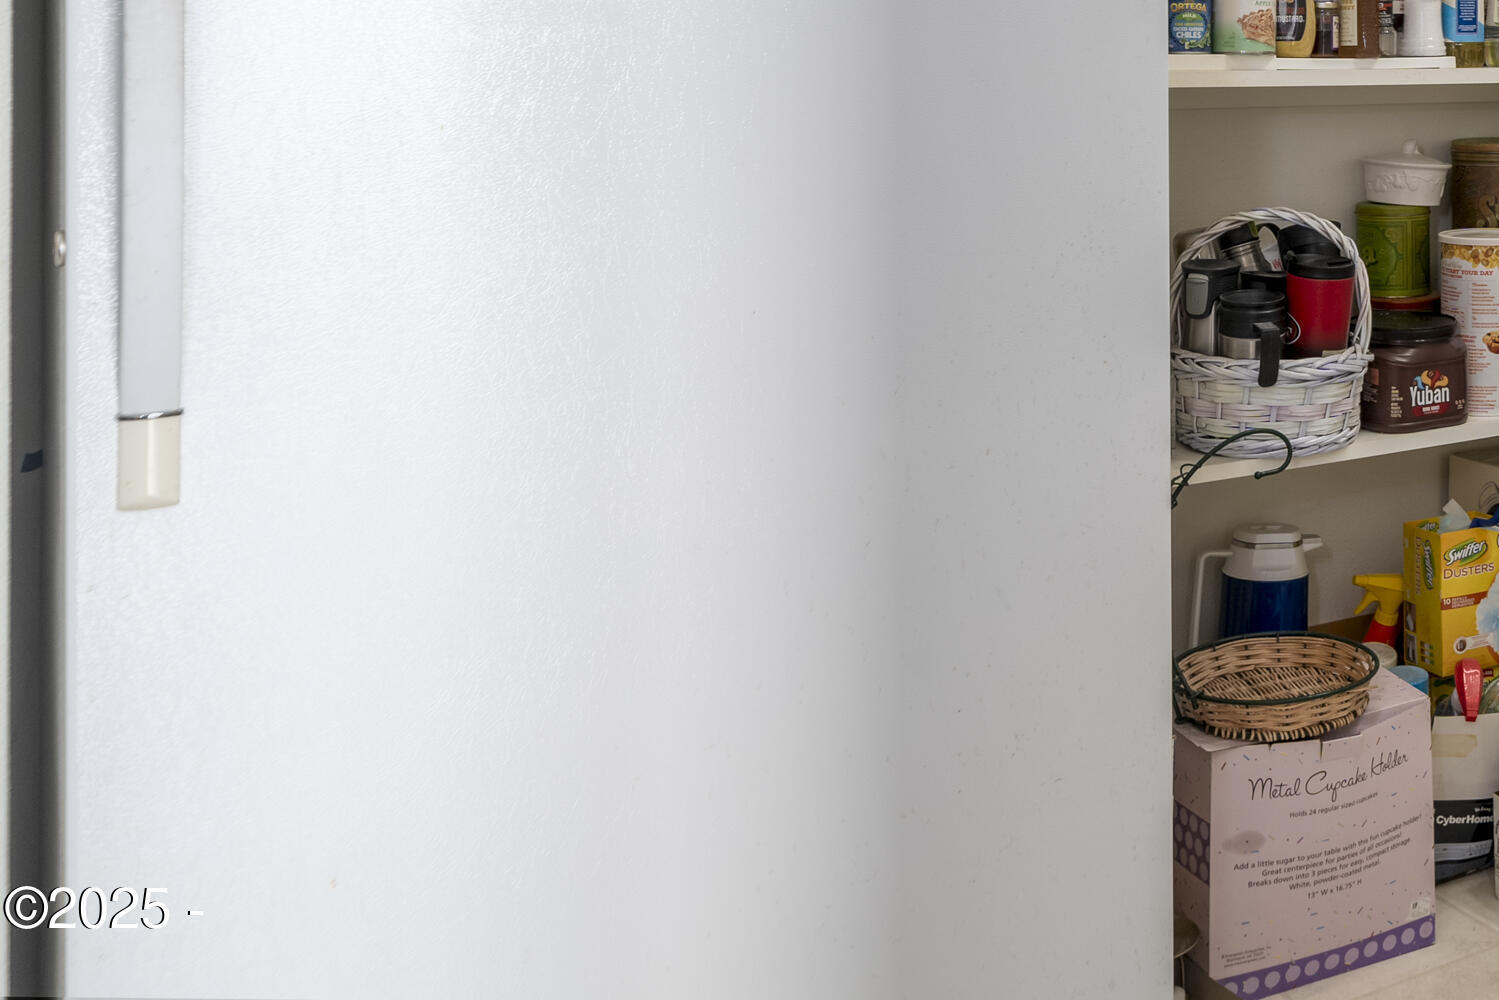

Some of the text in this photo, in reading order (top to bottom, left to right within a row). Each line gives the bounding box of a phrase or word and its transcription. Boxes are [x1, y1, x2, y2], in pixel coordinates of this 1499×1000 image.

[1170, 2, 1207, 13] ORTEGA
[1175, 31, 1202, 39] CHILES
[1409, 385, 1450, 407] Yuban
[1446, 540, 1487, 567] Swiffer
[1443, 562, 1495, 580] DUSTERS
[1442, 598, 1452, 606] 10
[1248, 749, 1409, 803] Metal Cupcake Holder
[1289, 810, 1308, 819] Holds
[1308, 808, 1317, 816] 24
[1317, 804, 1340, 815] regular
[1340, 798, 1356, 809] sized
[1233, 861, 1249, 871] Add
[1257, 859, 1275, 868] little
[1276, 856, 1296, 866] sugar
[1306, 851, 1323, 861] your
[1324, 847, 1342, 856] table
[1342, 841, 1357, 851] with
[1357, 838, 1369, 847] this
[1380, 823, 1402, 838] cupcake
[1261, 867, 1282, 877] Great
[1283, 860, 1324, 874] centerpiece
[1336, 852, 1359, 863] parties
[1247, 879, 1272, 889] Breaks
[1273, 874, 1294, 885] down
[1295, 872, 1310, 881] into
[1316, 866, 1338, 878] pieces
[1313, 866, 1363, 887] powder-coated
